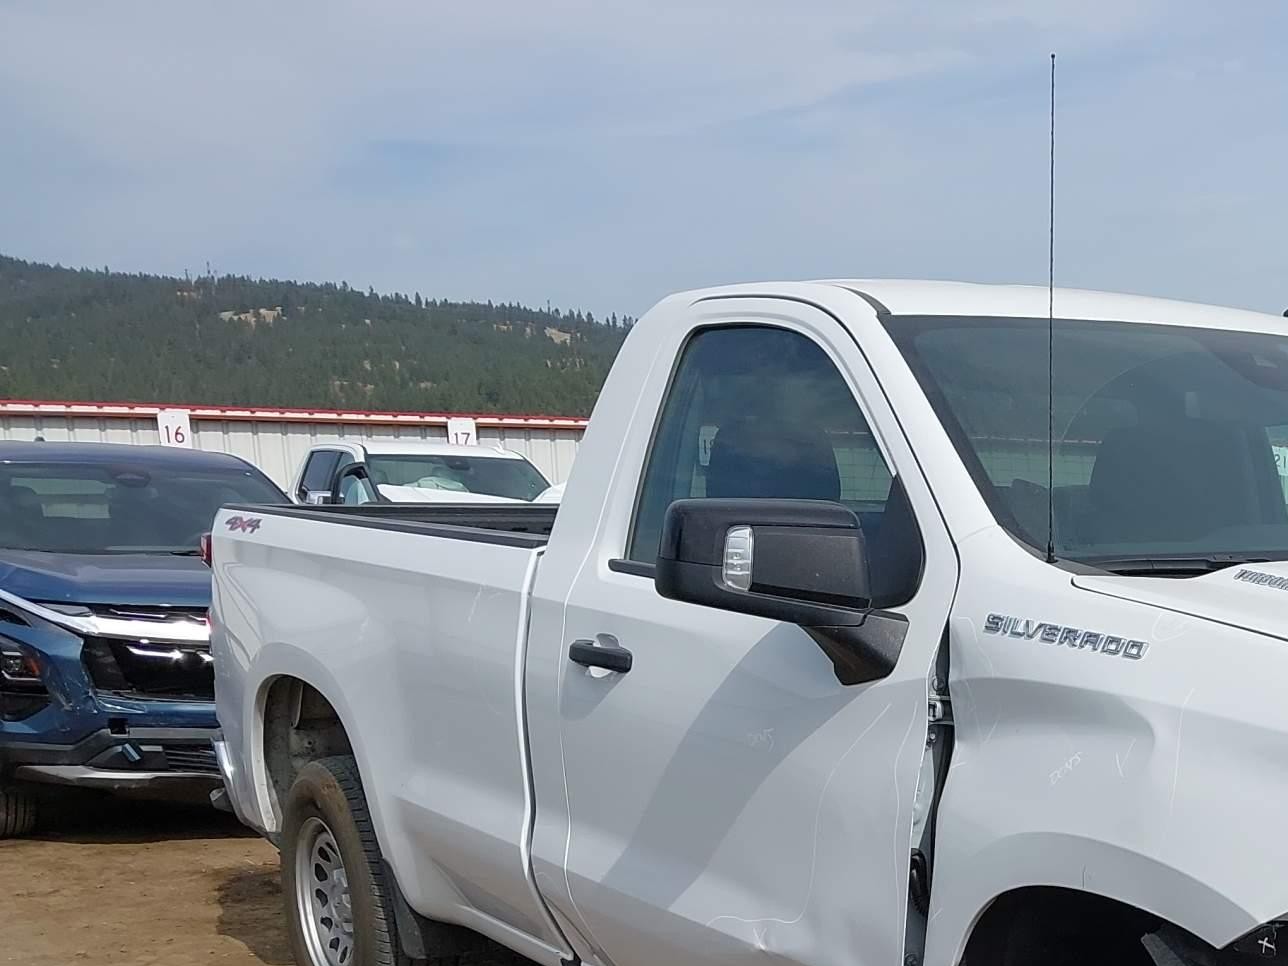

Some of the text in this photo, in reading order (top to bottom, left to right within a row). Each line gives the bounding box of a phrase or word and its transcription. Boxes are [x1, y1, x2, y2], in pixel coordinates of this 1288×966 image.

[164, 425, 185, 444] 16
[454, 431, 471, 446] 17
[983, 613, 1149, 660] SILVERADO
